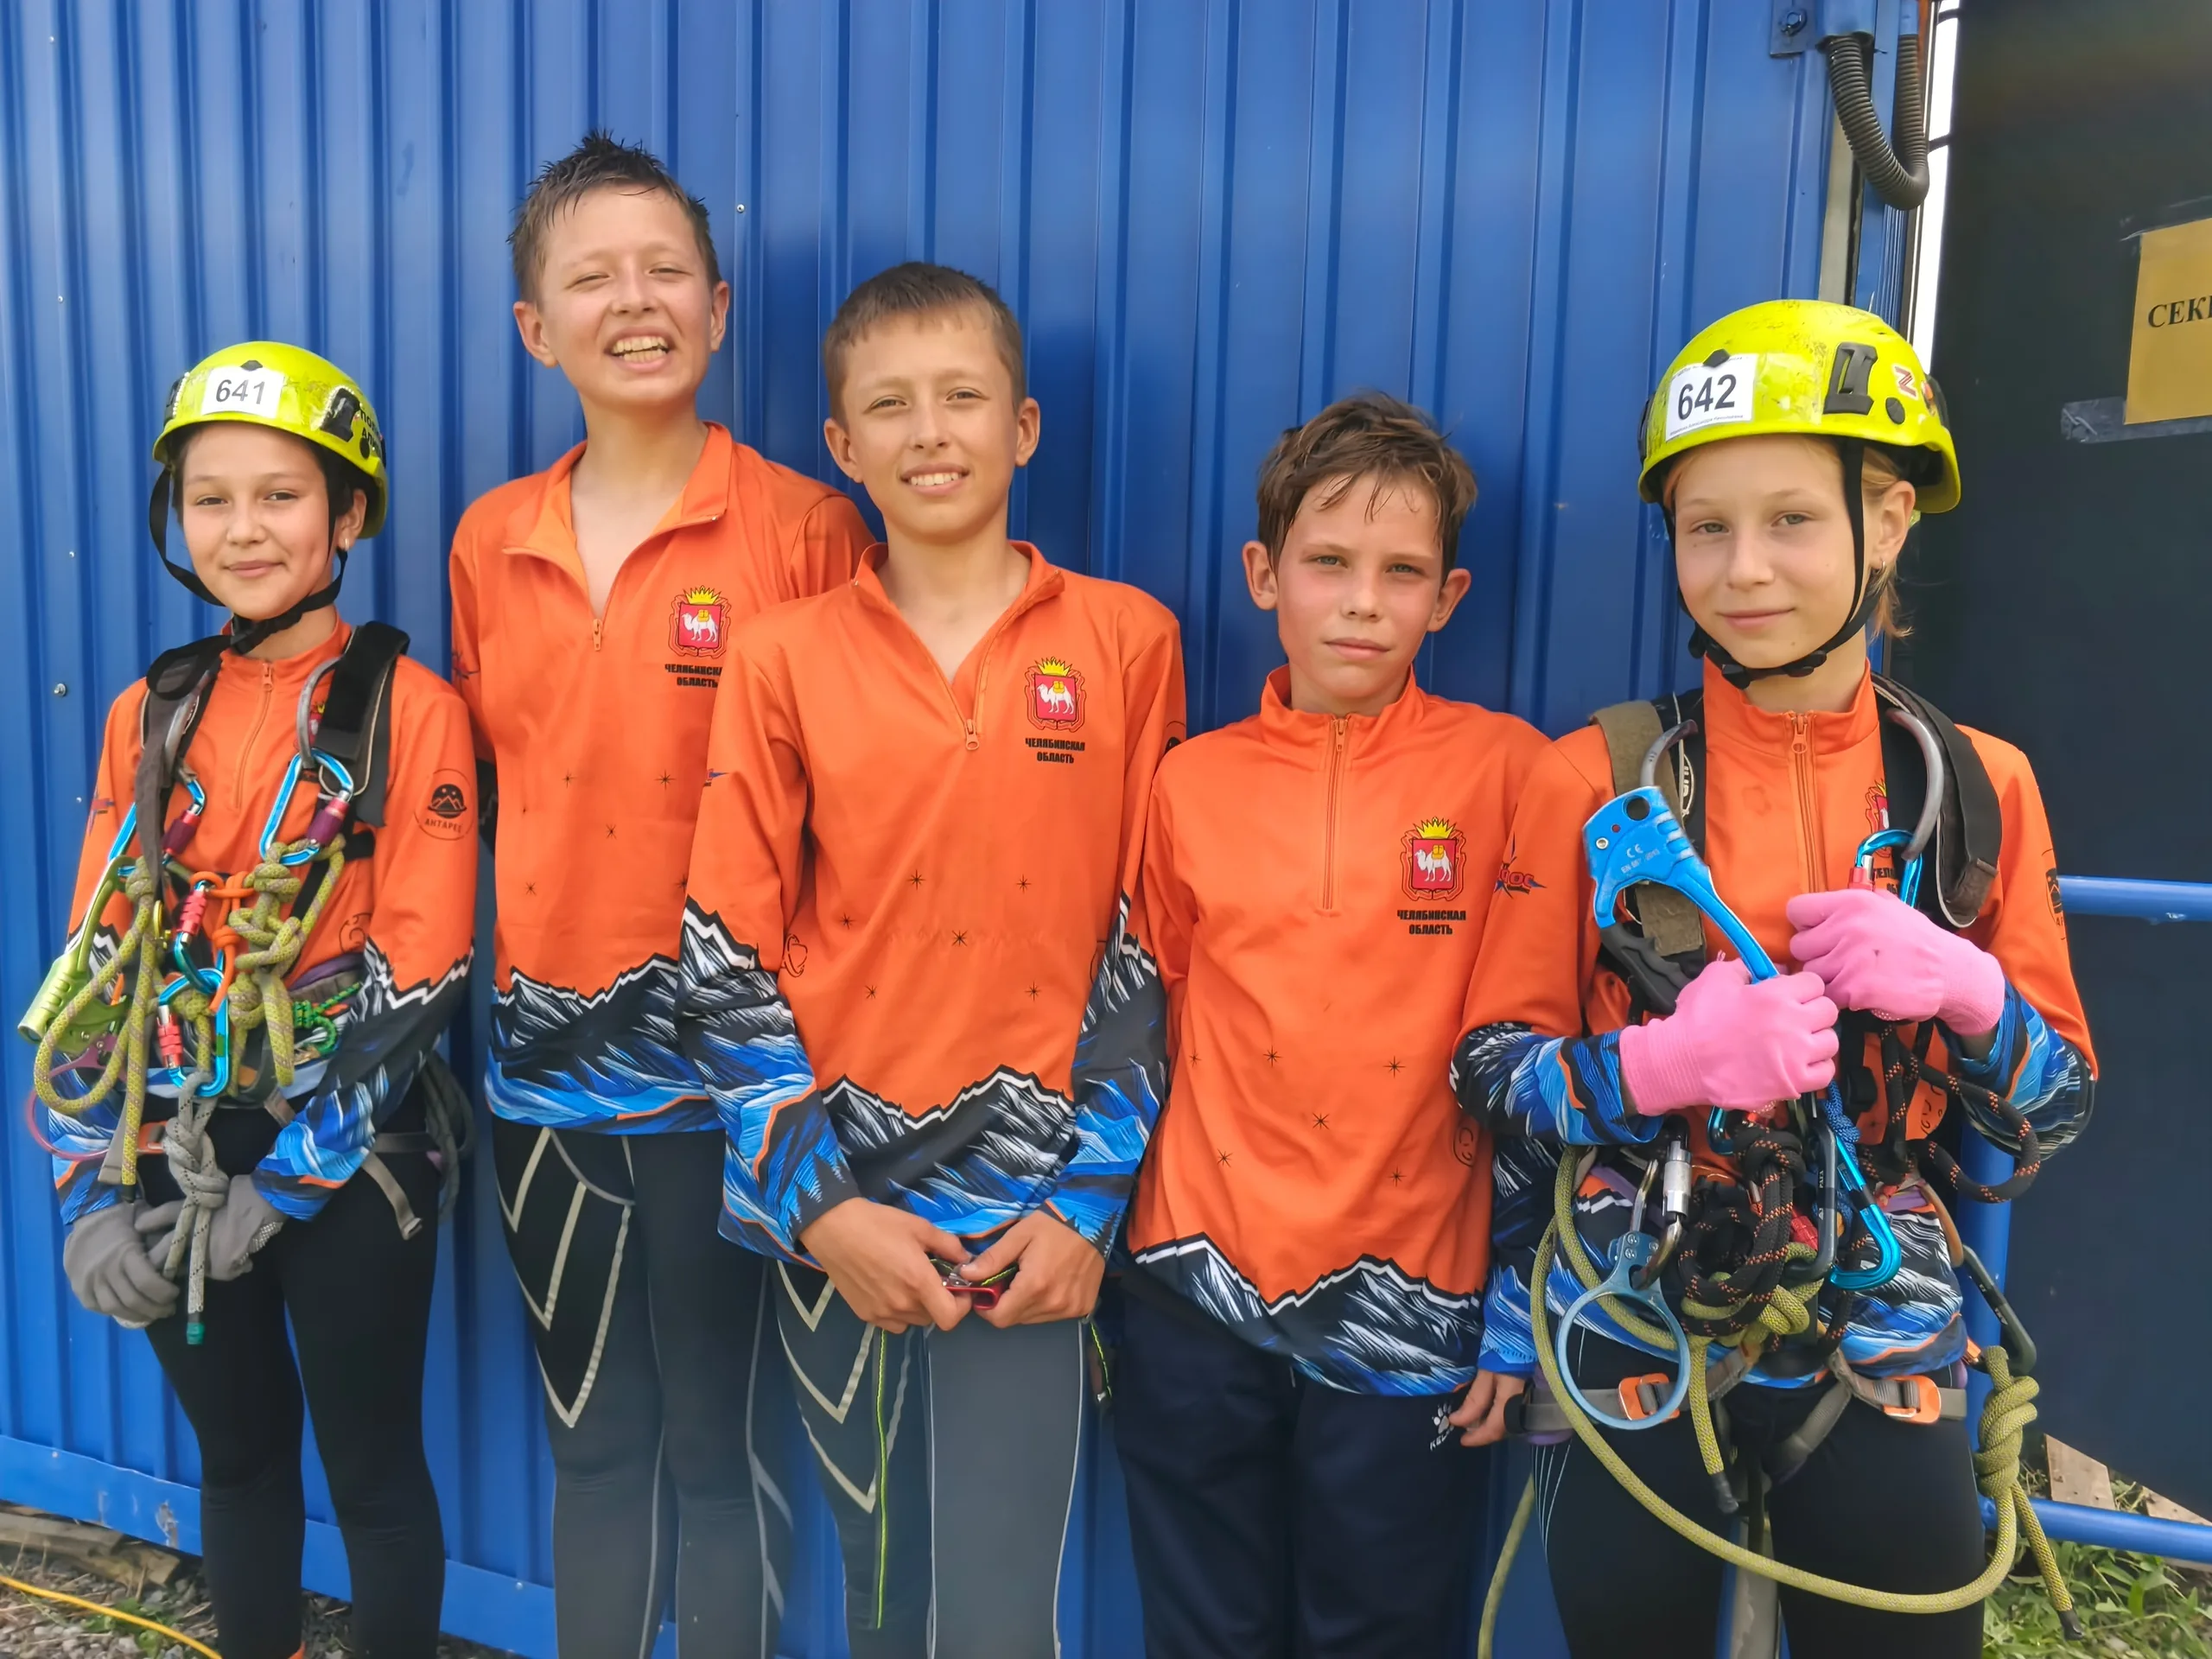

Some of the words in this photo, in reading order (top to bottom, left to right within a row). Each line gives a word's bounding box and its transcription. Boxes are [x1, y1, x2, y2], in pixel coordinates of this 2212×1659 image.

[216, 378, 265, 405] 641
[1678, 374, 1737, 421] 642
[1025, 737, 1086, 752] ЧЕЛЯБИНСКАЯ
[1037, 751, 1074, 764] ОБЛАСТЬ
[1397, 909, 1466, 921] ЧЕЛЯБИНСКАЯ
[1408, 924, 1453, 935] ОБЛАСТЬ
